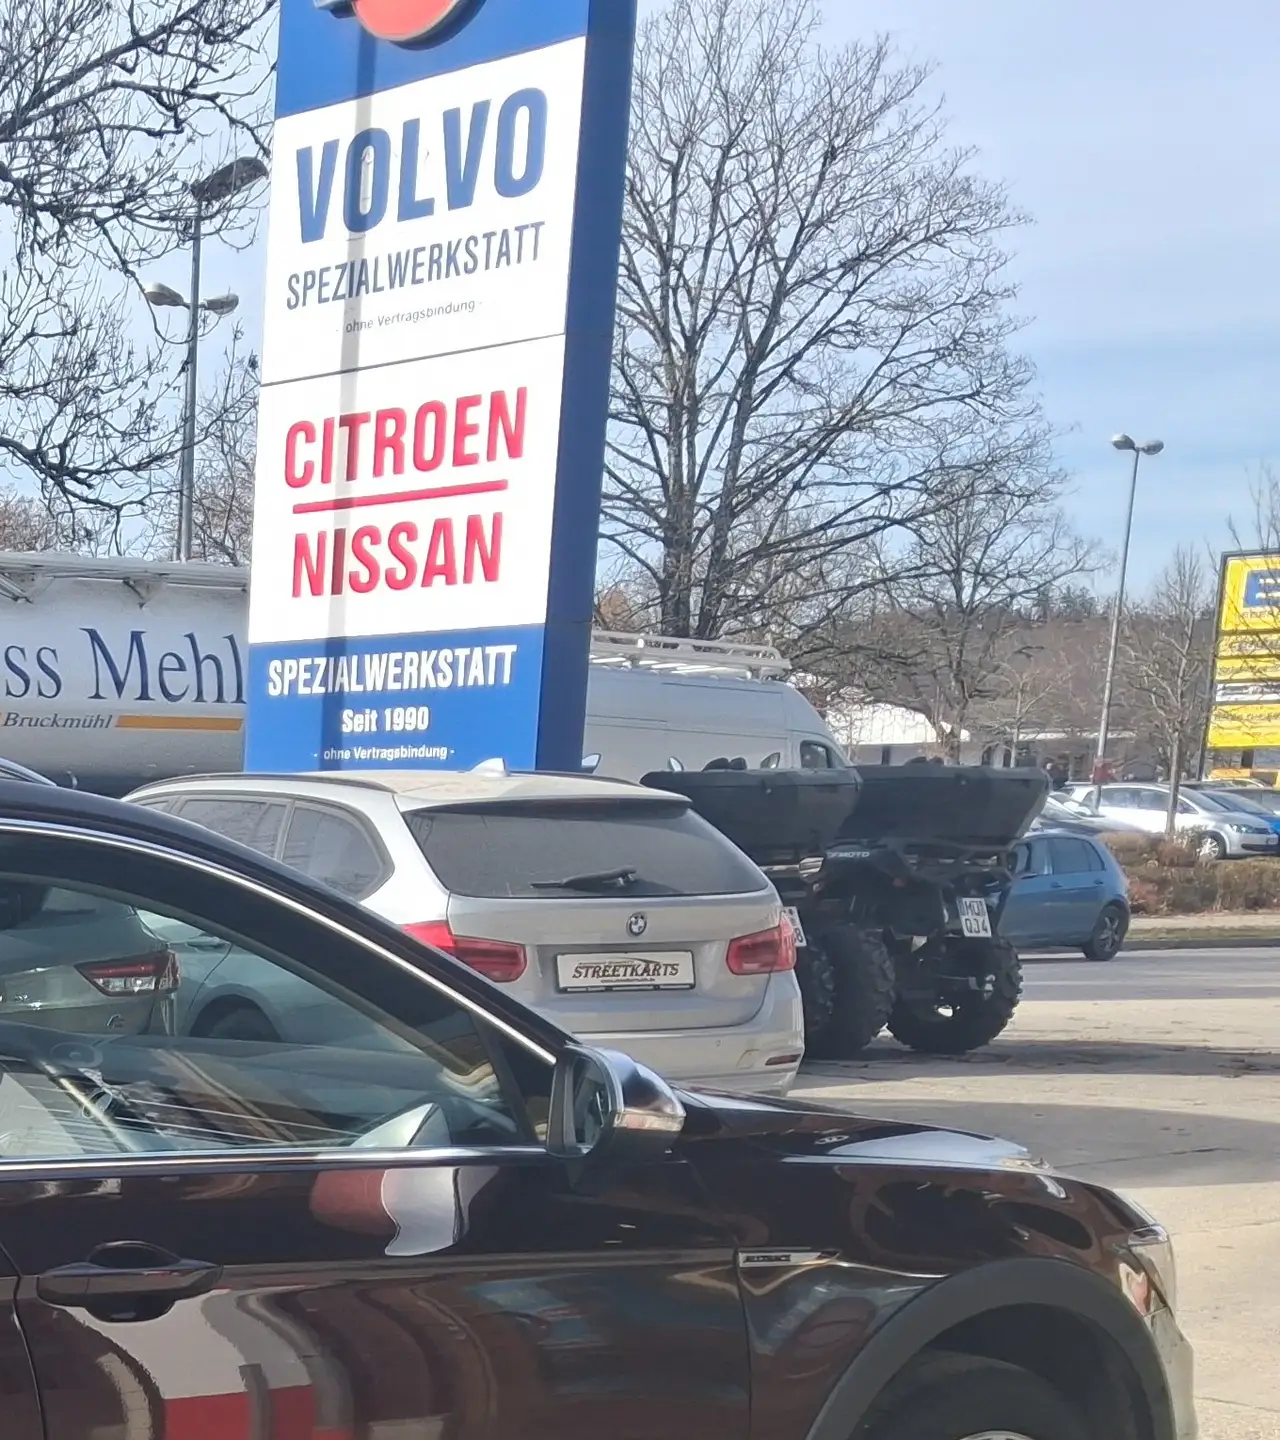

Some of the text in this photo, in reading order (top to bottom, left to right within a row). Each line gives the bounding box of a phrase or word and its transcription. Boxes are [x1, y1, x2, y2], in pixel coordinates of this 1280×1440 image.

[296, 87, 548, 243] VOLVO
[286, 221, 546, 310] SPEZIALWERKSTATT
[345, 300, 475, 333] ohne Vertragsbindung
[284, 386, 528, 488] CITROEN
[291, 512, 503, 597] NISSAN
[80, 627, 247, 704] Mehl
[268, 644, 517, 696] SPEZIALWERKSTATT
[3, 711, 113, 729] Bruckmühl
[342, 706, 429, 733] Seit 1990
[323, 744, 448, 762] ohne Vertragsbindung
[572, 963, 679, 979] STREETKARTS
